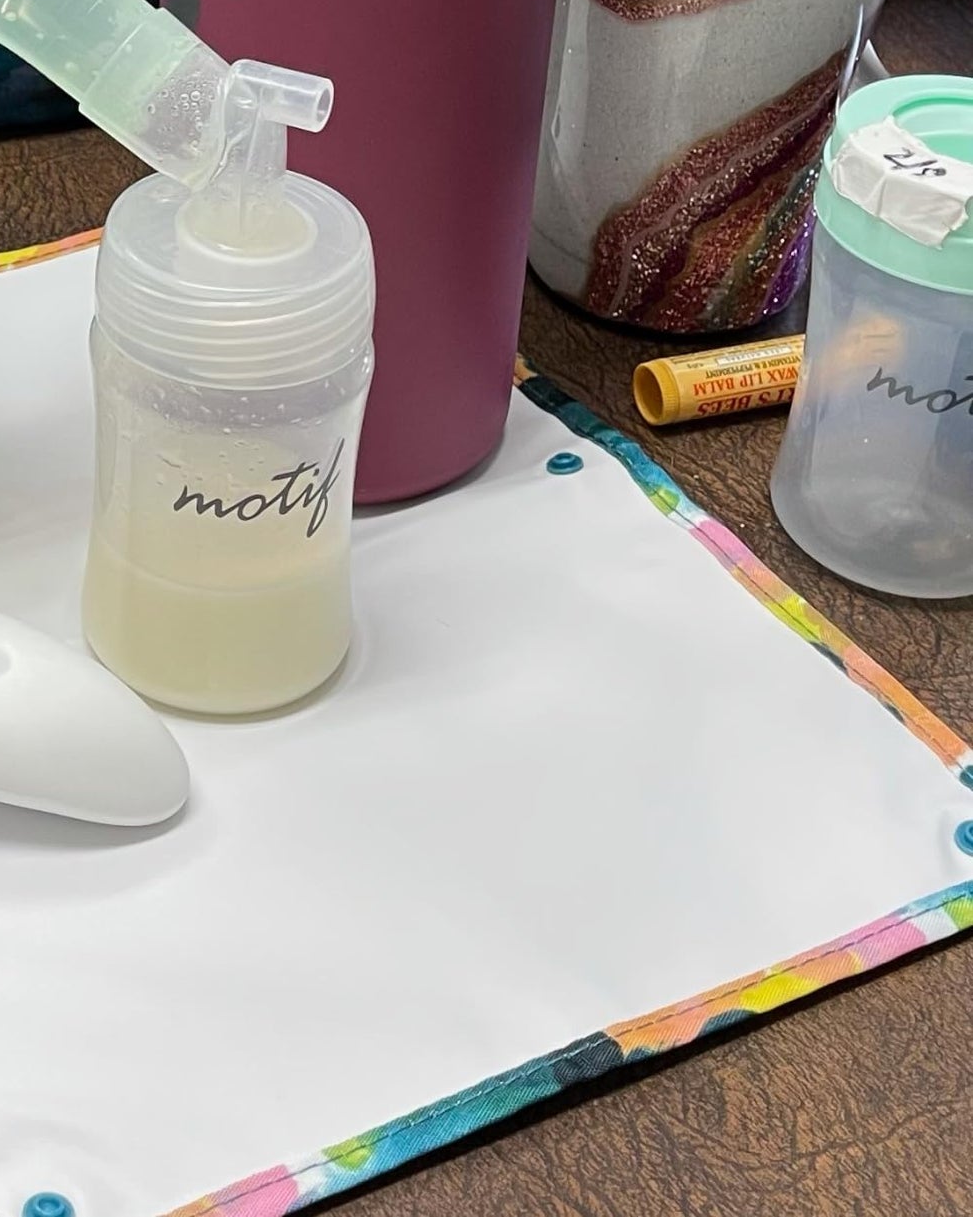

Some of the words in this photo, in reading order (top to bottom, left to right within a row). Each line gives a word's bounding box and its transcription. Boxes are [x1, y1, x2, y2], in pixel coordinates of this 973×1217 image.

[693, 380, 734, 396] BALM
[740, 372, 763, 388] LIP
[697, 394, 752, 416] BEES
[173, 437, 345, 538] motif
